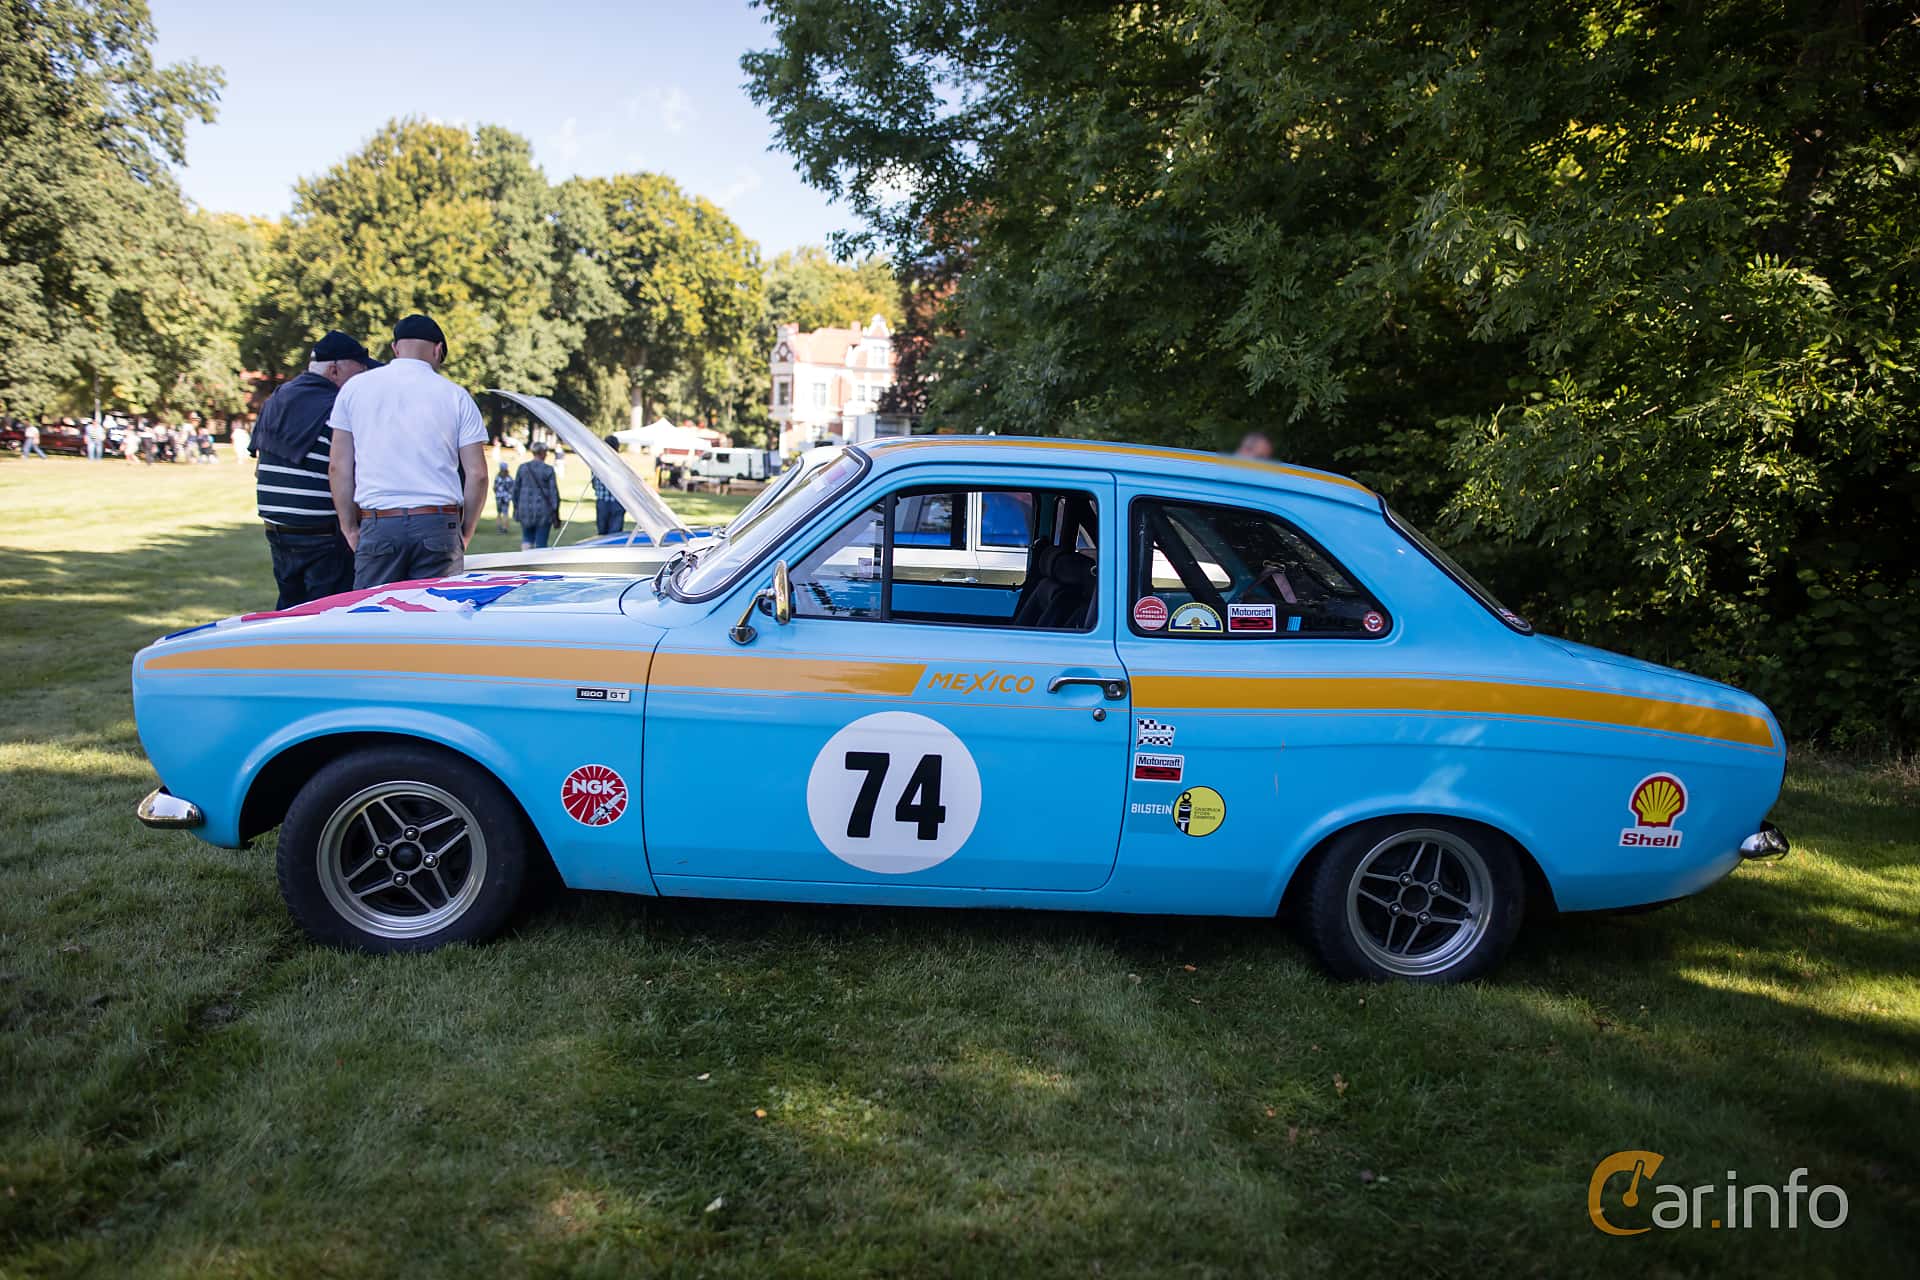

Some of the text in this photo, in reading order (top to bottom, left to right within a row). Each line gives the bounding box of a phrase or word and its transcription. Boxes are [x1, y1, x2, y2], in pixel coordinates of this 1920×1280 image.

[1231, 607, 1272, 616] Motorcraft
[927, 669, 1035, 695] MEXICO
[610, 691, 627, 700] GT
[1138, 756, 1181, 768] Motorcraft
[571, 779, 618, 795] NGK
[845, 751, 946, 840] 74
[1130, 803, 1172, 815] BILSTEIN
[1622, 832, 1680, 847] Shell
